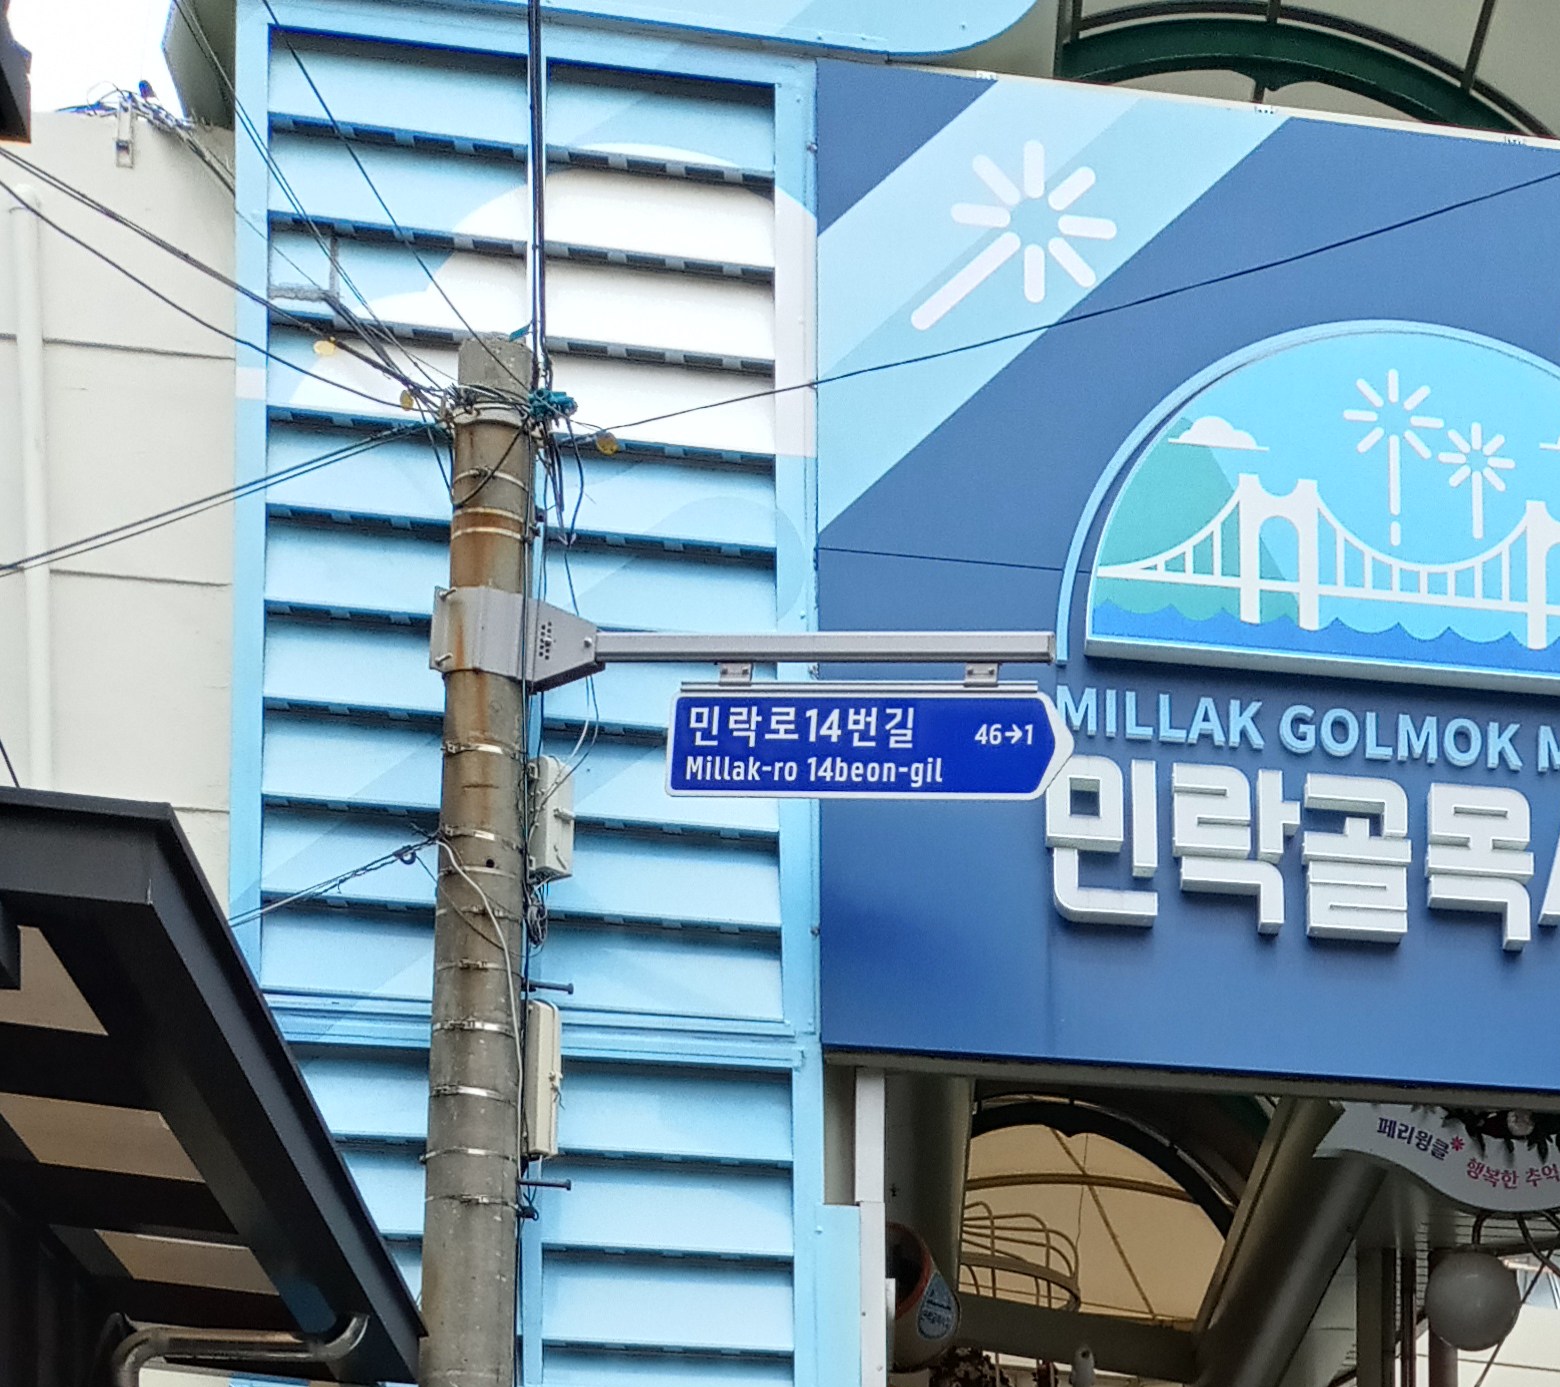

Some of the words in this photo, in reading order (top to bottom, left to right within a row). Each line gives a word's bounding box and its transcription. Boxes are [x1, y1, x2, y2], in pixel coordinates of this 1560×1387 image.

[688, 705, 915, 749] 민락로14번길
[1058, 685, 1265, 751] MILLAK
[1278, 704, 1520, 773] GOLMOK
[686, 756, 797, 782] Millak-ro
[806, 756, 943, 788] 14beon-gil
[1377, 1117, 1450, 1160] 페리윙클
[1466, 1157, 1519, 1189] 행복한
[1526, 1164, 1560, 1187] 추억
